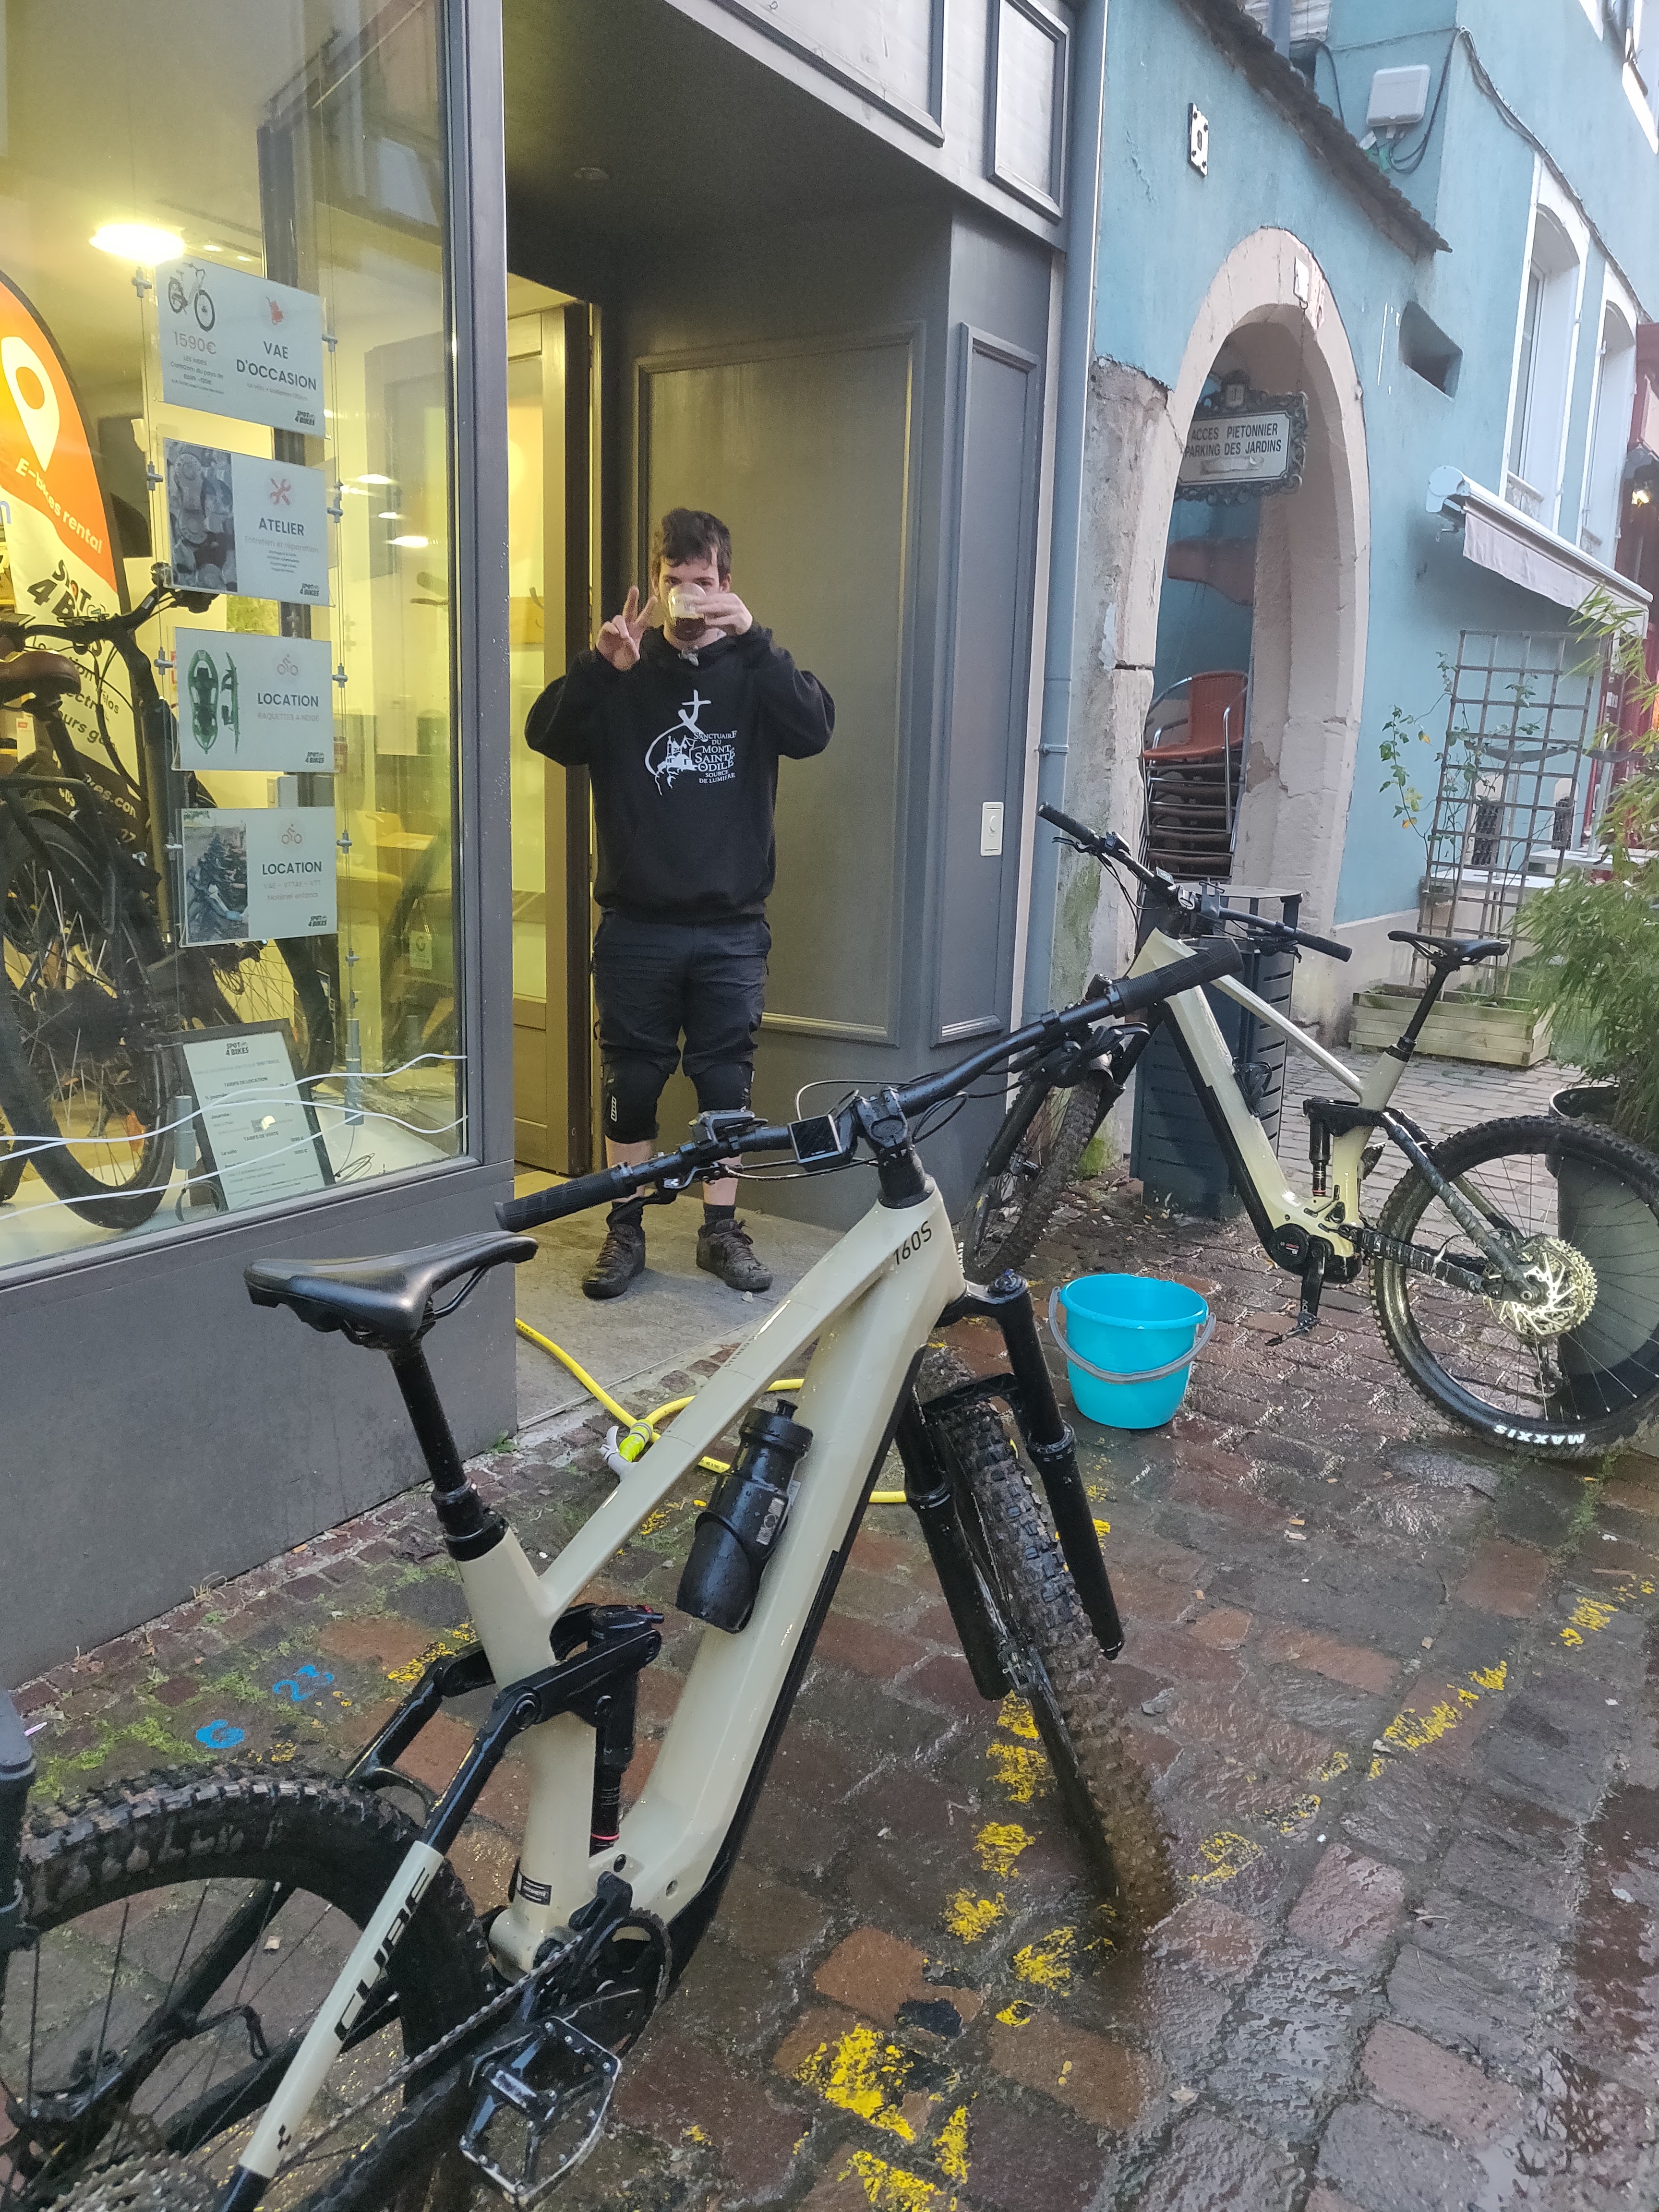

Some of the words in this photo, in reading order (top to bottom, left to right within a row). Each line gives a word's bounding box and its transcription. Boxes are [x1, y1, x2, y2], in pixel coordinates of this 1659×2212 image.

[174, 332, 216, 354] 1590€
[264, 341, 289, 359] VAE
[237, 359, 316, 390] D'OCCASION
[1191, 427, 1219, 441] ACCES
[1226, 423, 1278, 439] PIETONNIER
[1184, 445, 1220, 457] PARKING
[1224, 442, 1241, 456] DES
[1245, 440, 1282, 454] JARDINS
[62, 510, 102, 554] rental
[259, 517, 305, 536] ATELIER
[27, 579, 58, 606] 4
[258, 693, 319, 707] LOCATION
[694, 730, 737, 740] SANCTUAIRE
[695, 747, 735, 764] SAINTE
[702, 745, 732, 753] MONT
[698, 759, 734, 772] ODILE
[262, 861, 322, 875] LOCATION
[231, 1047, 249, 1056] BIKES
[893, 1220, 932, 1265] 160S
[1493, 1424, 1586, 1444] MAXXIS
[334, 1866, 430, 2042] CUBE
